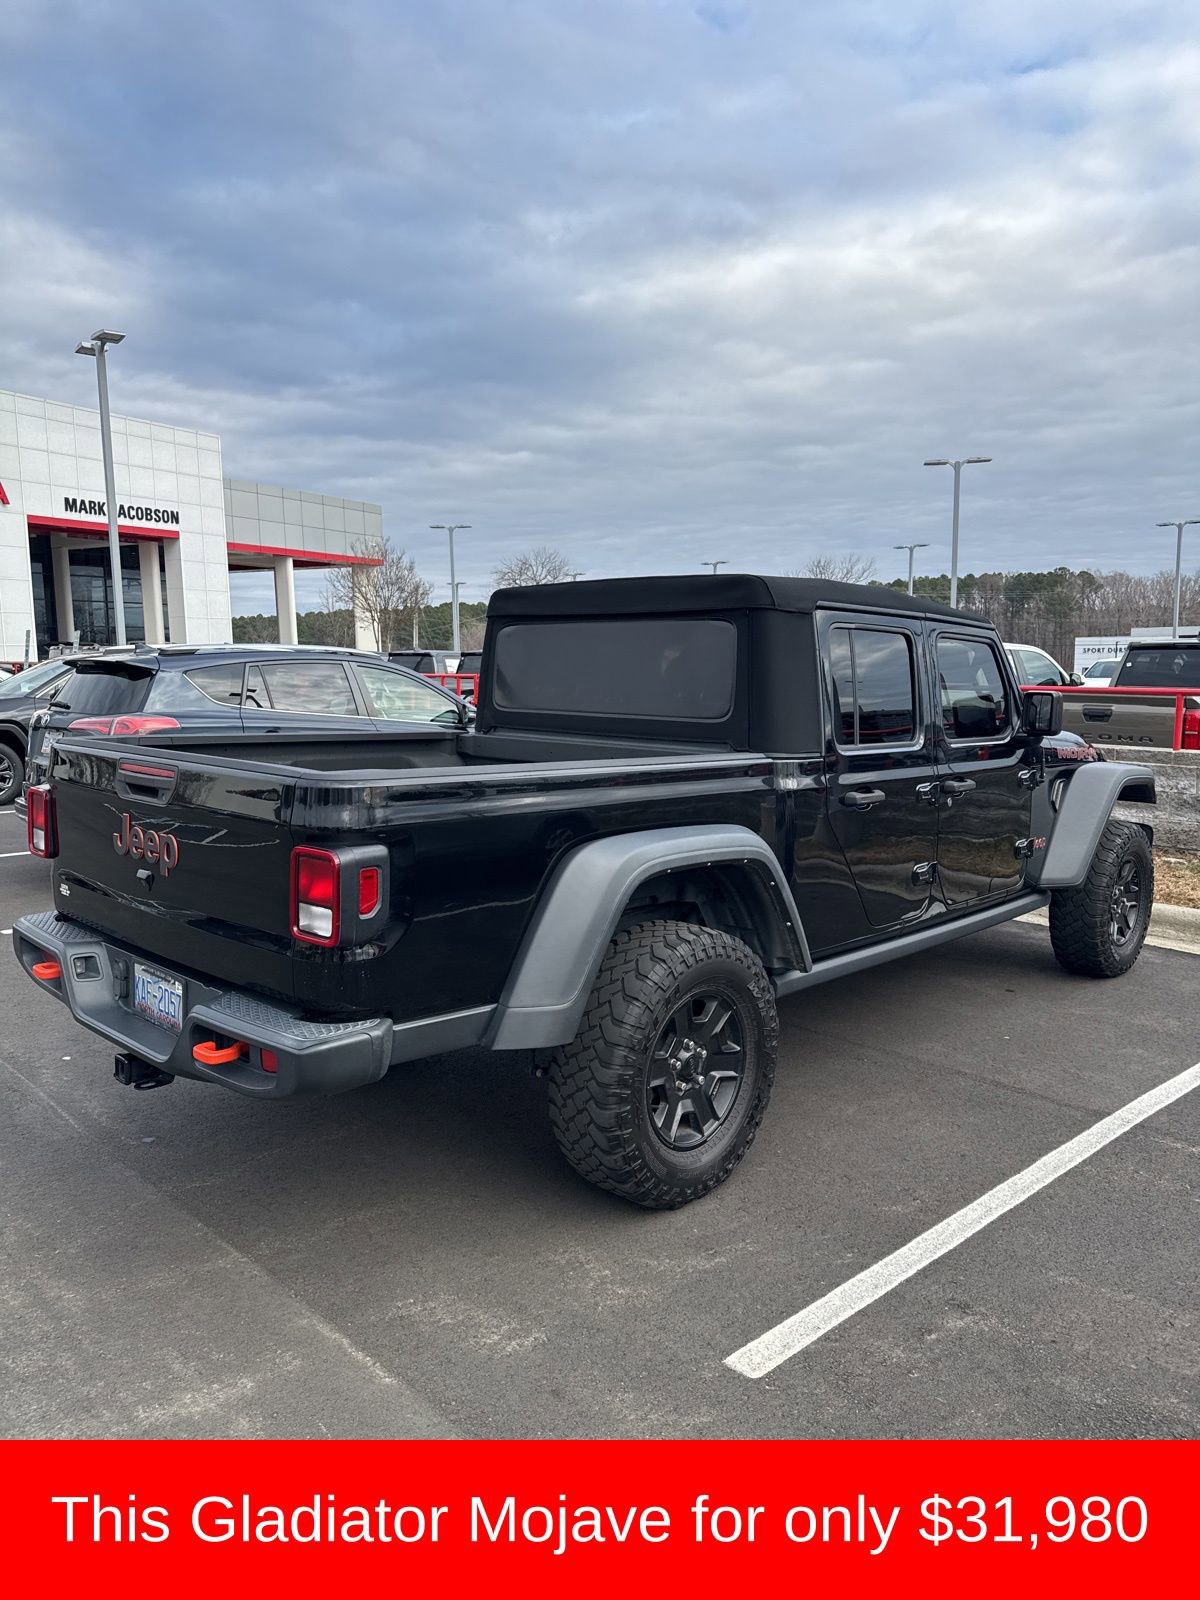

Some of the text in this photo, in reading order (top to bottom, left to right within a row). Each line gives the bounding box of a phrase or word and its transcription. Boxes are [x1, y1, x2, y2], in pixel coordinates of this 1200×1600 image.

[64, 497, 180, 525] MARK ACOBSON
[1081, 733, 1153, 744] COMA
[113, 813, 178, 878] Jeep
